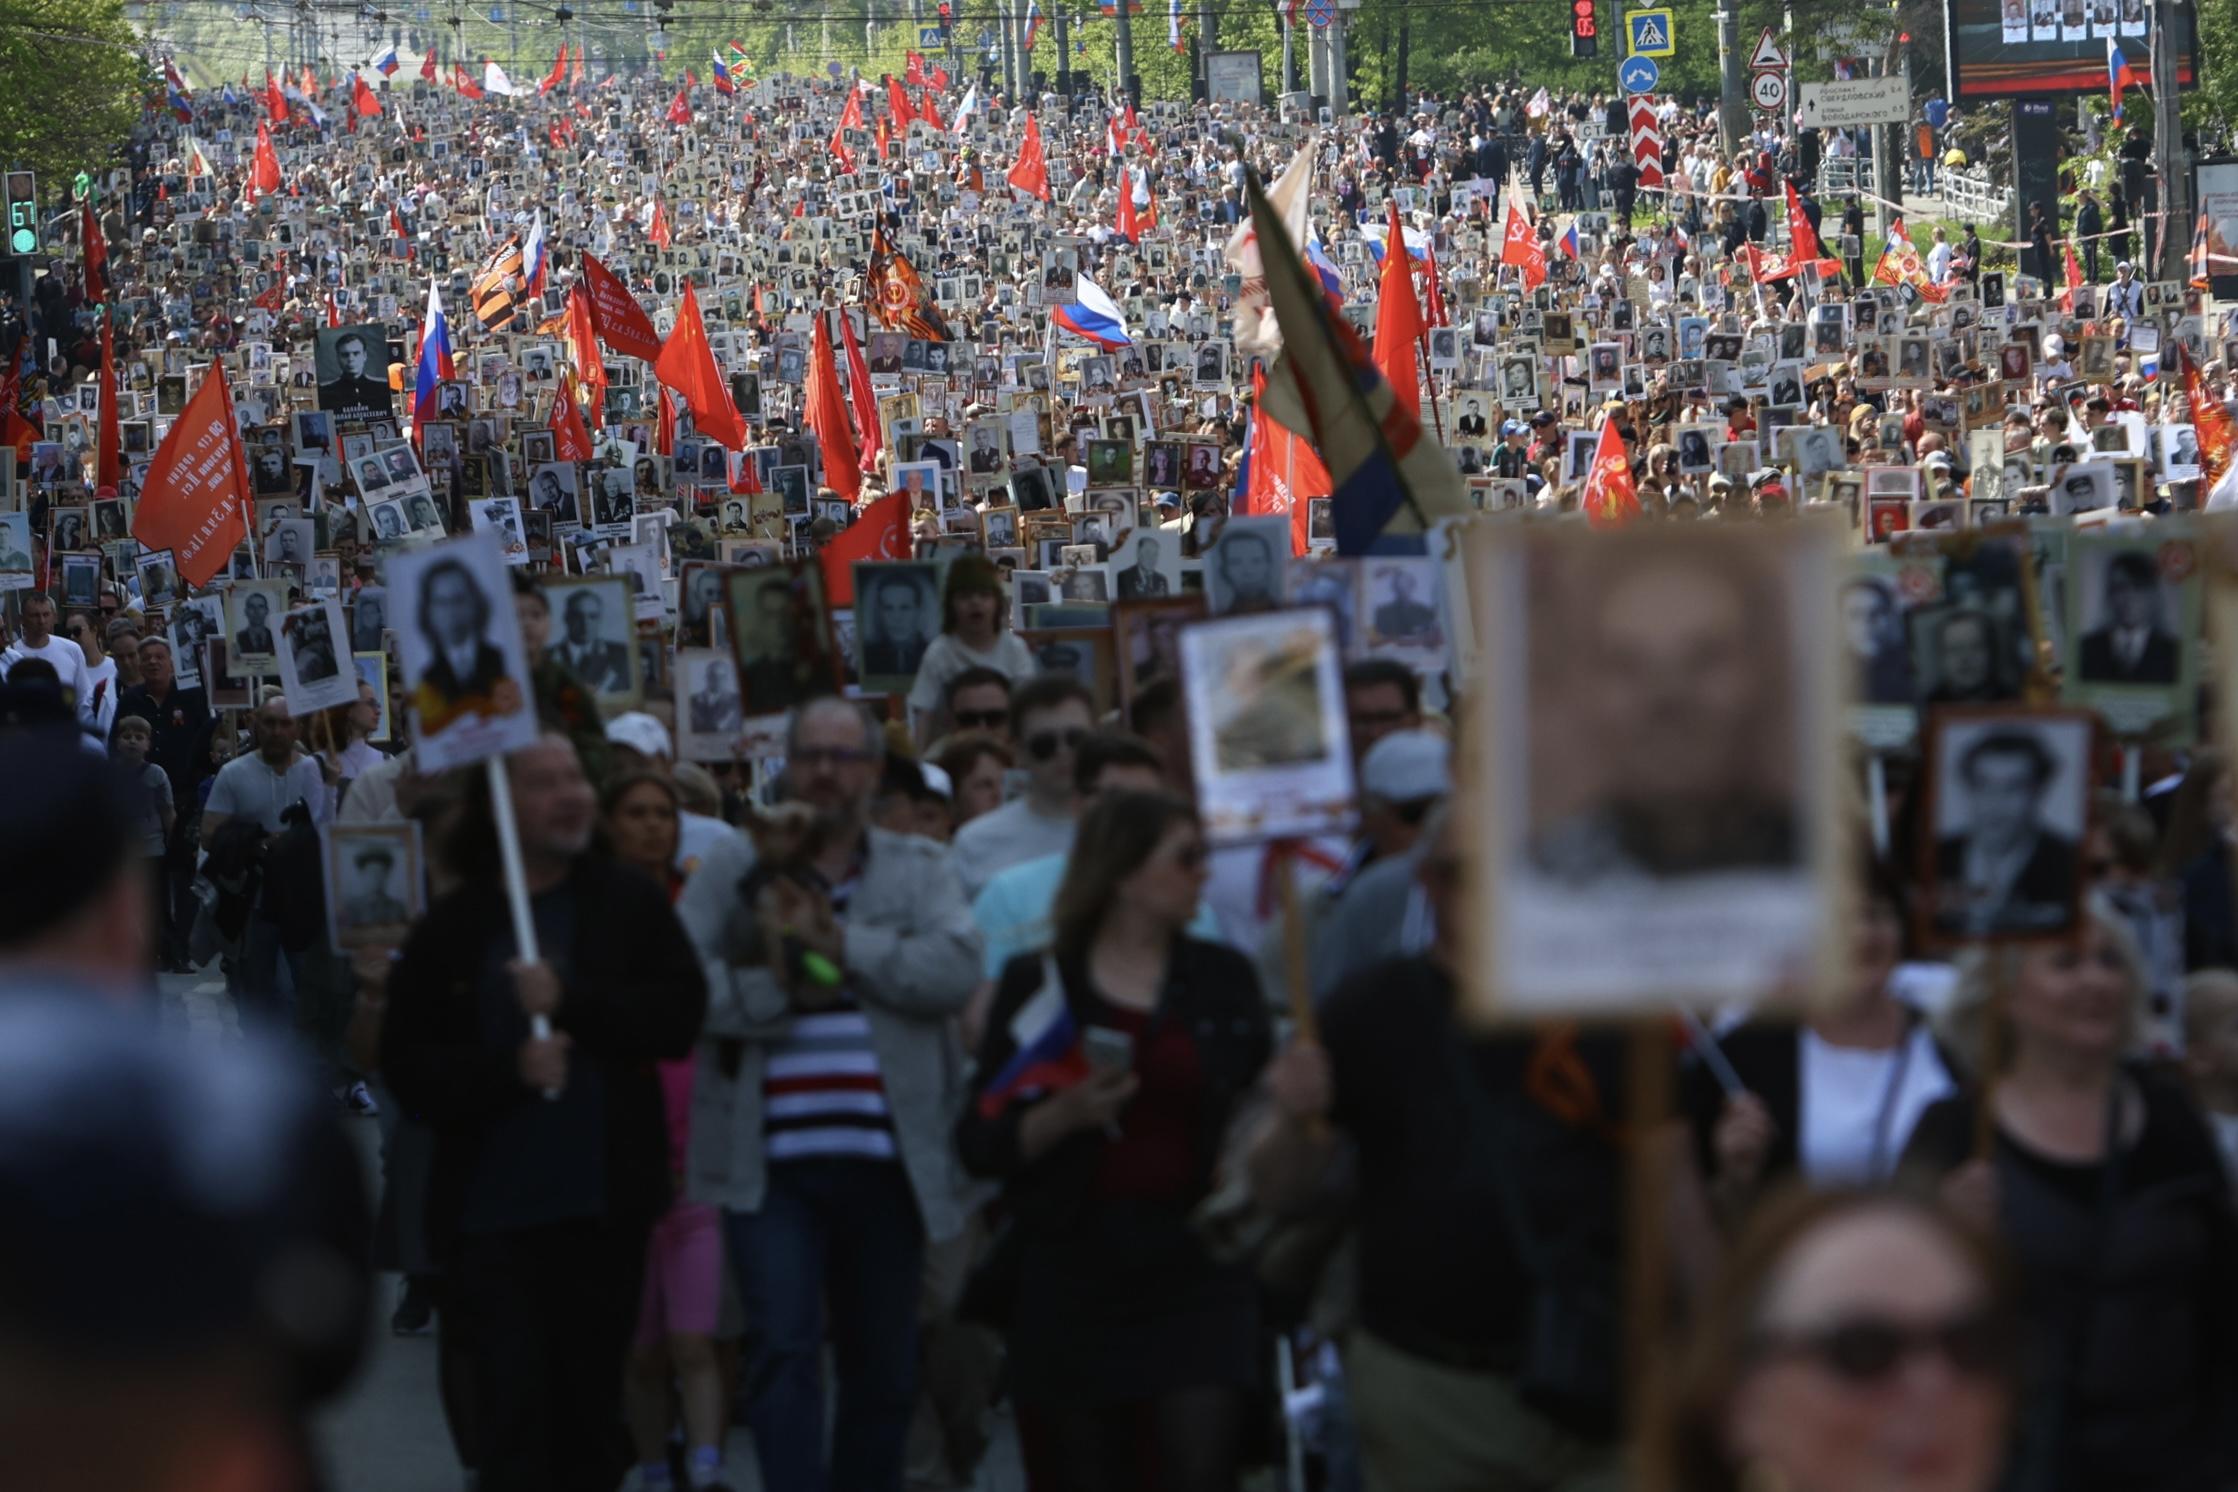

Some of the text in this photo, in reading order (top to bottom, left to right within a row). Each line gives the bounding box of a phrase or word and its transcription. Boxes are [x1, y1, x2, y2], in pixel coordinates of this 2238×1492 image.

[1760, 83, 1779, 98] 40
[1583, 125, 1609, 137] СТ
[11, 201, 36, 227] 67
